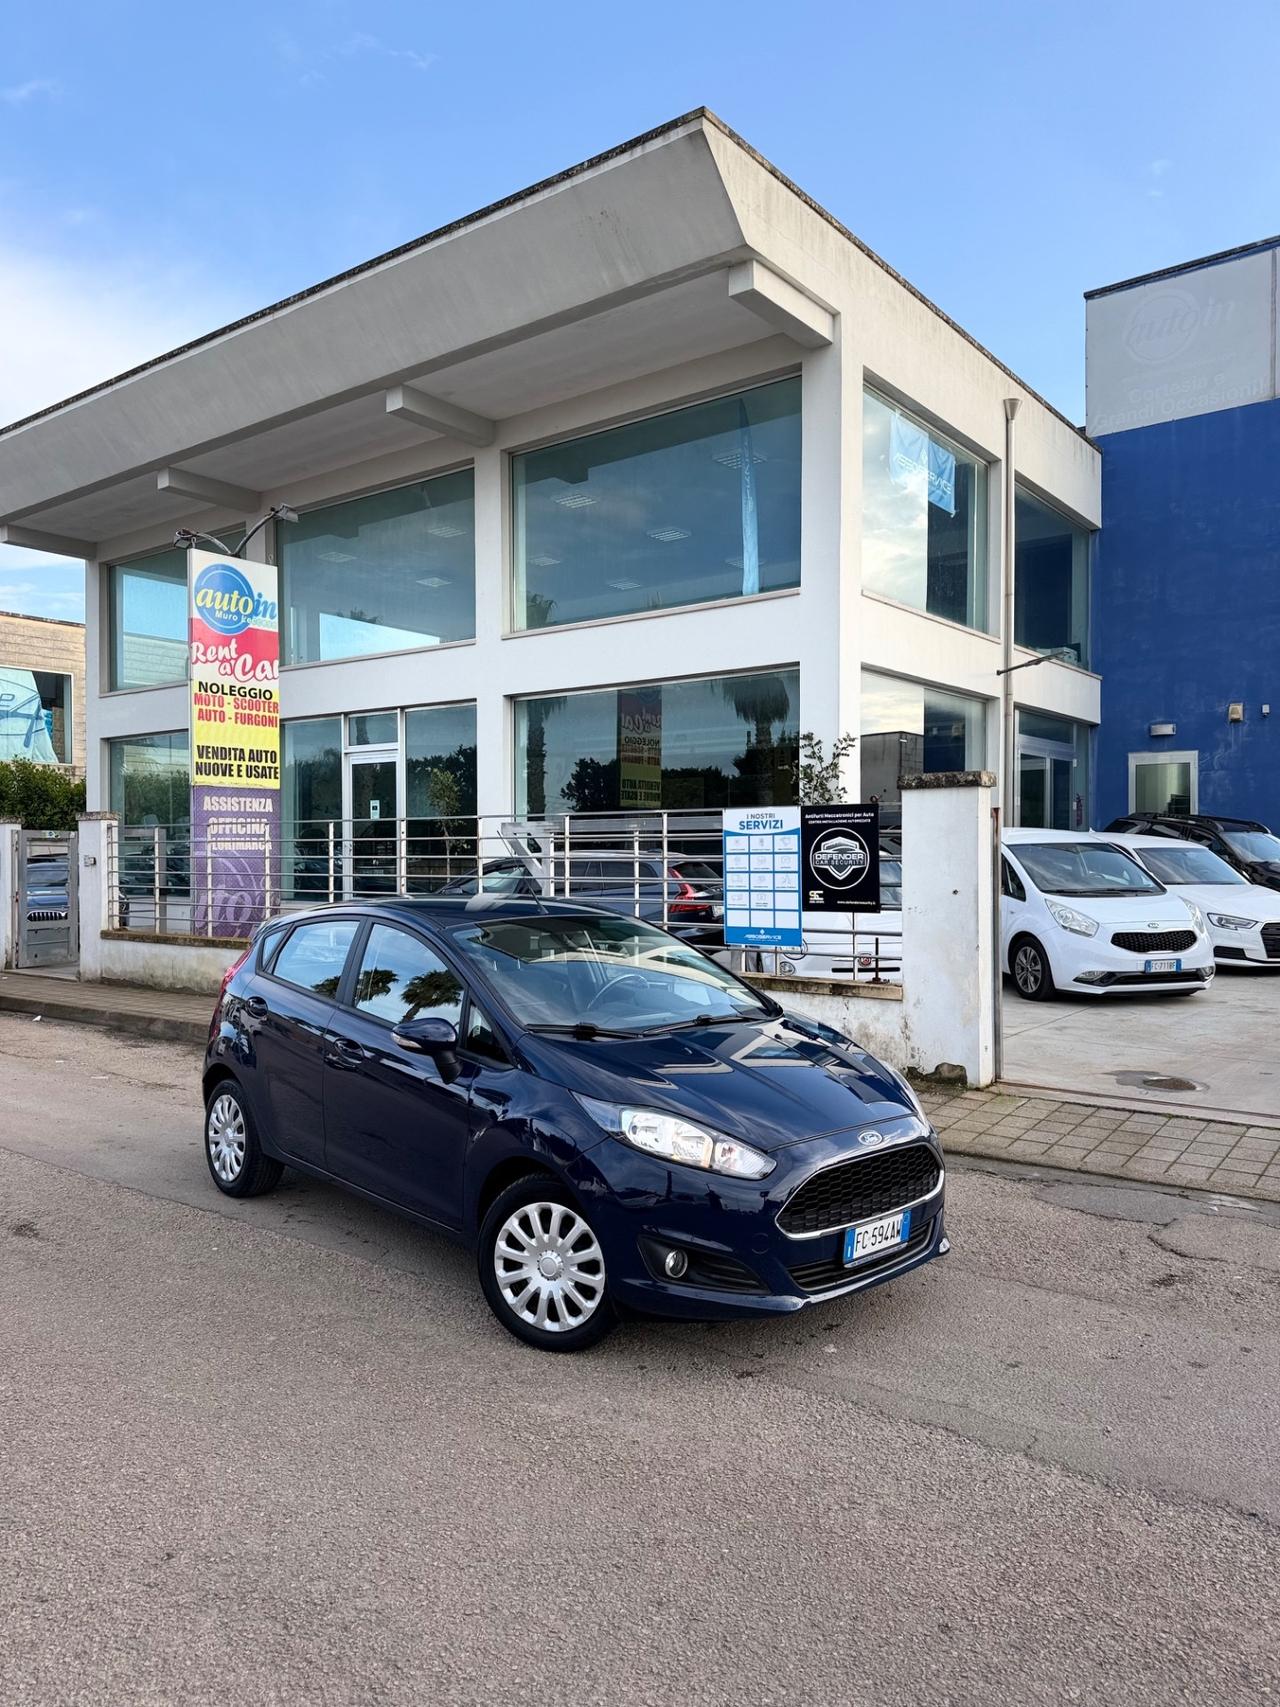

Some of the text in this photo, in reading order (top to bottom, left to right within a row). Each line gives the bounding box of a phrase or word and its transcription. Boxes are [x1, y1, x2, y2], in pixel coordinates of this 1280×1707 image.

[215, 611, 238, 622] Muro
[191, 638, 238, 663] Rent
[198, 681, 273, 700] NOLEGGIO
[194, 692, 225, 708] MOTO
[233, 697, 279, 714] SCOOTER
[197, 708, 226, 723] AUTO
[234, 712, 278, 728] FURGONI
[196, 745, 277, 764] VENDITA AUTO
[195, 761, 279, 779] NUOVE E USATE
[203, 796, 273, 812] ASSISTENZA
[739, 819, 783, 830] SERVIZI
[855, 1230, 868, 1252] FC
